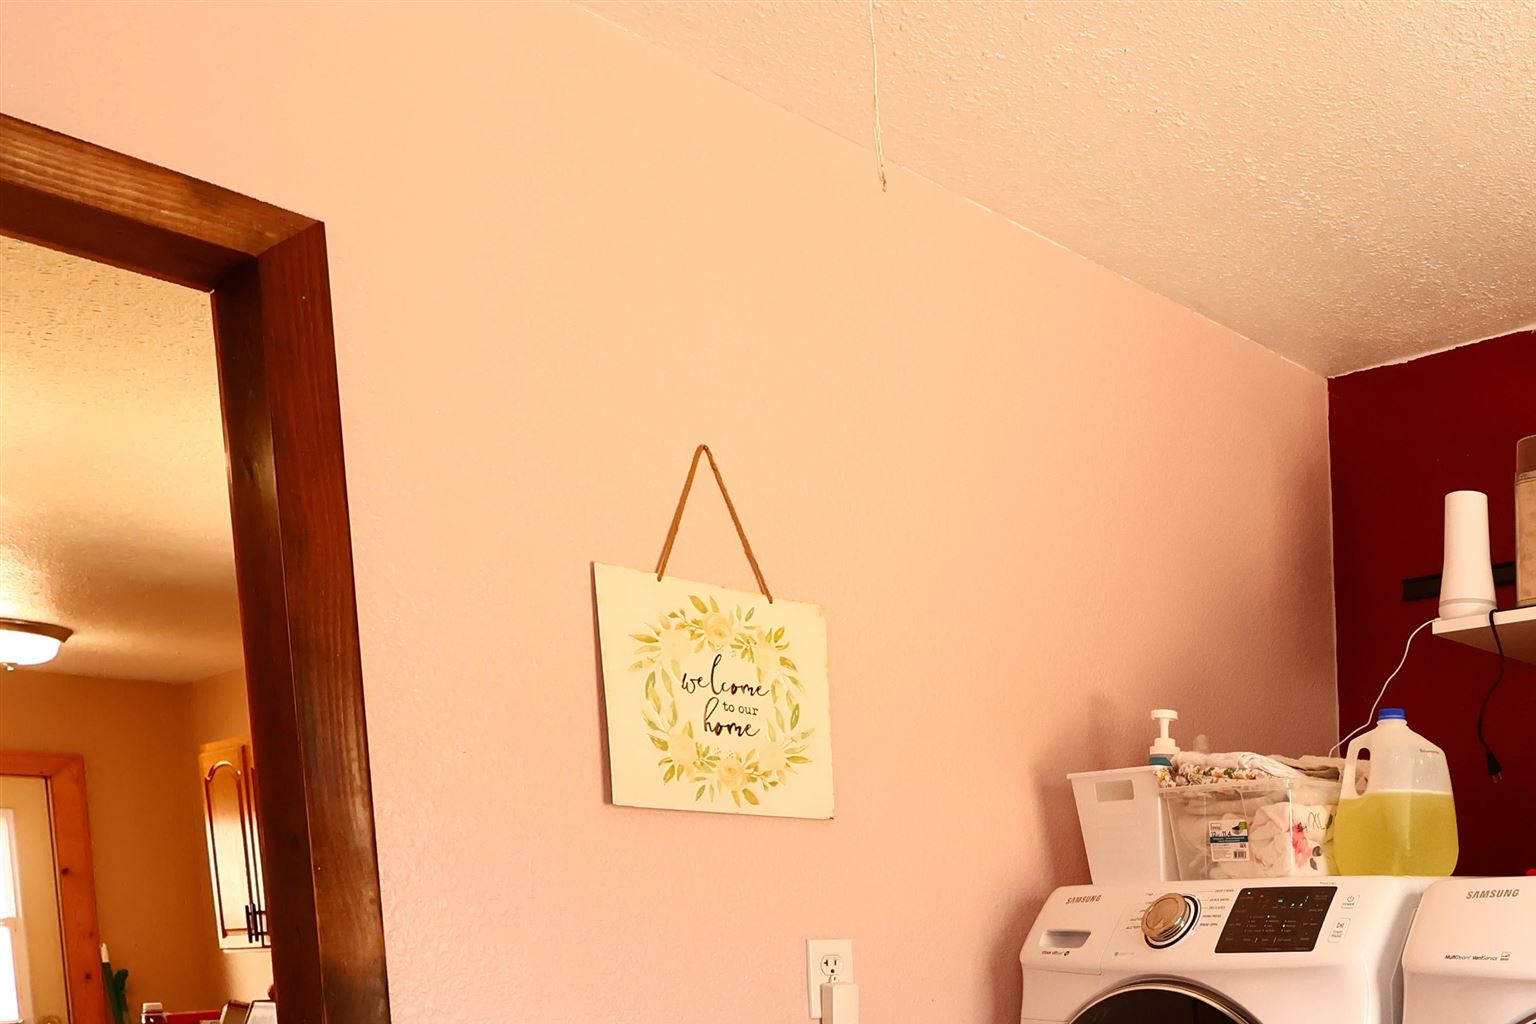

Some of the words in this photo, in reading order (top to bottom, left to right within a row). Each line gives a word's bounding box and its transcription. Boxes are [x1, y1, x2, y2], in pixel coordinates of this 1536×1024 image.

[681, 653, 769, 696] welcome
[722, 701, 735, 712] to
[738, 706, 759, 715] our
[704, 697, 760, 737] home
[1065, 894, 1102, 905] SAMSUNG
[1466, 888, 1520, 900] SAMSUNG
